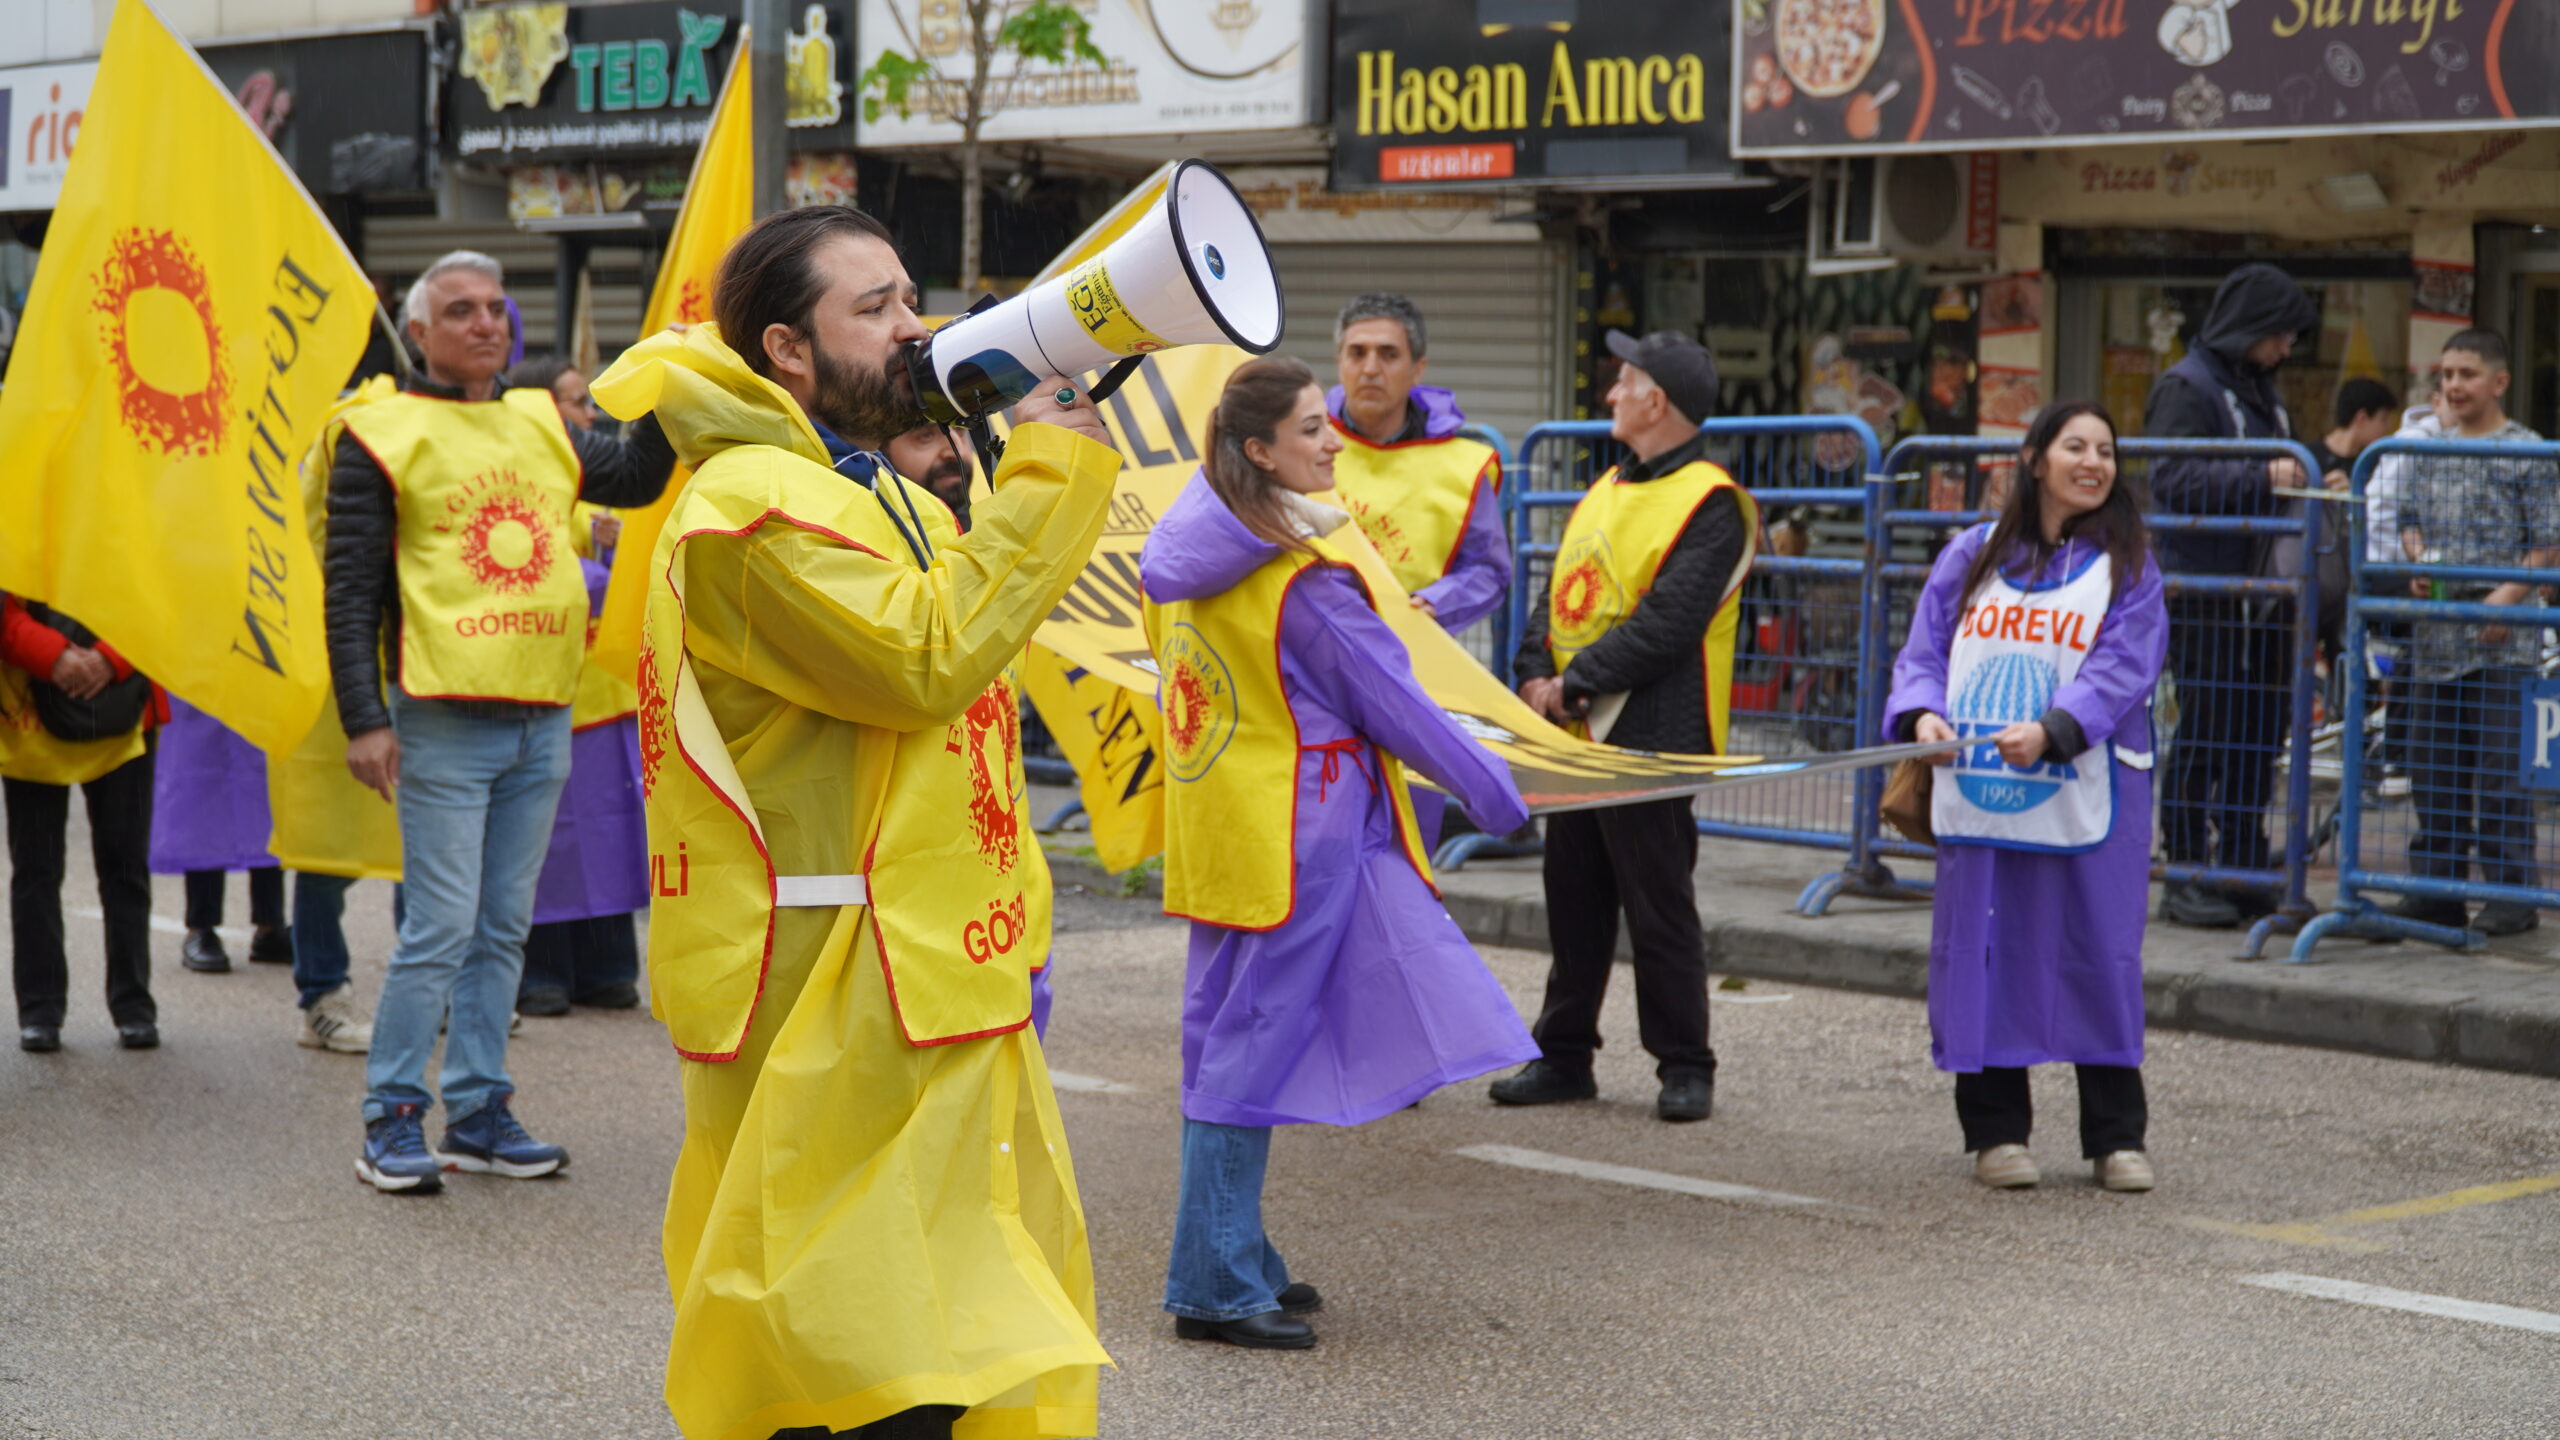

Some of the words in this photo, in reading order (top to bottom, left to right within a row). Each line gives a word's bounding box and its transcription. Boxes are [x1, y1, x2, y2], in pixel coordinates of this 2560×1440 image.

[570, 38, 712, 113] TEBA
[1357, 50, 1527, 135] Hasan
[1541, 40, 1705, 128] Amca
[455, 606, 569, 637] GÖREVLİ
[1981, 784, 2026, 809] 1995
